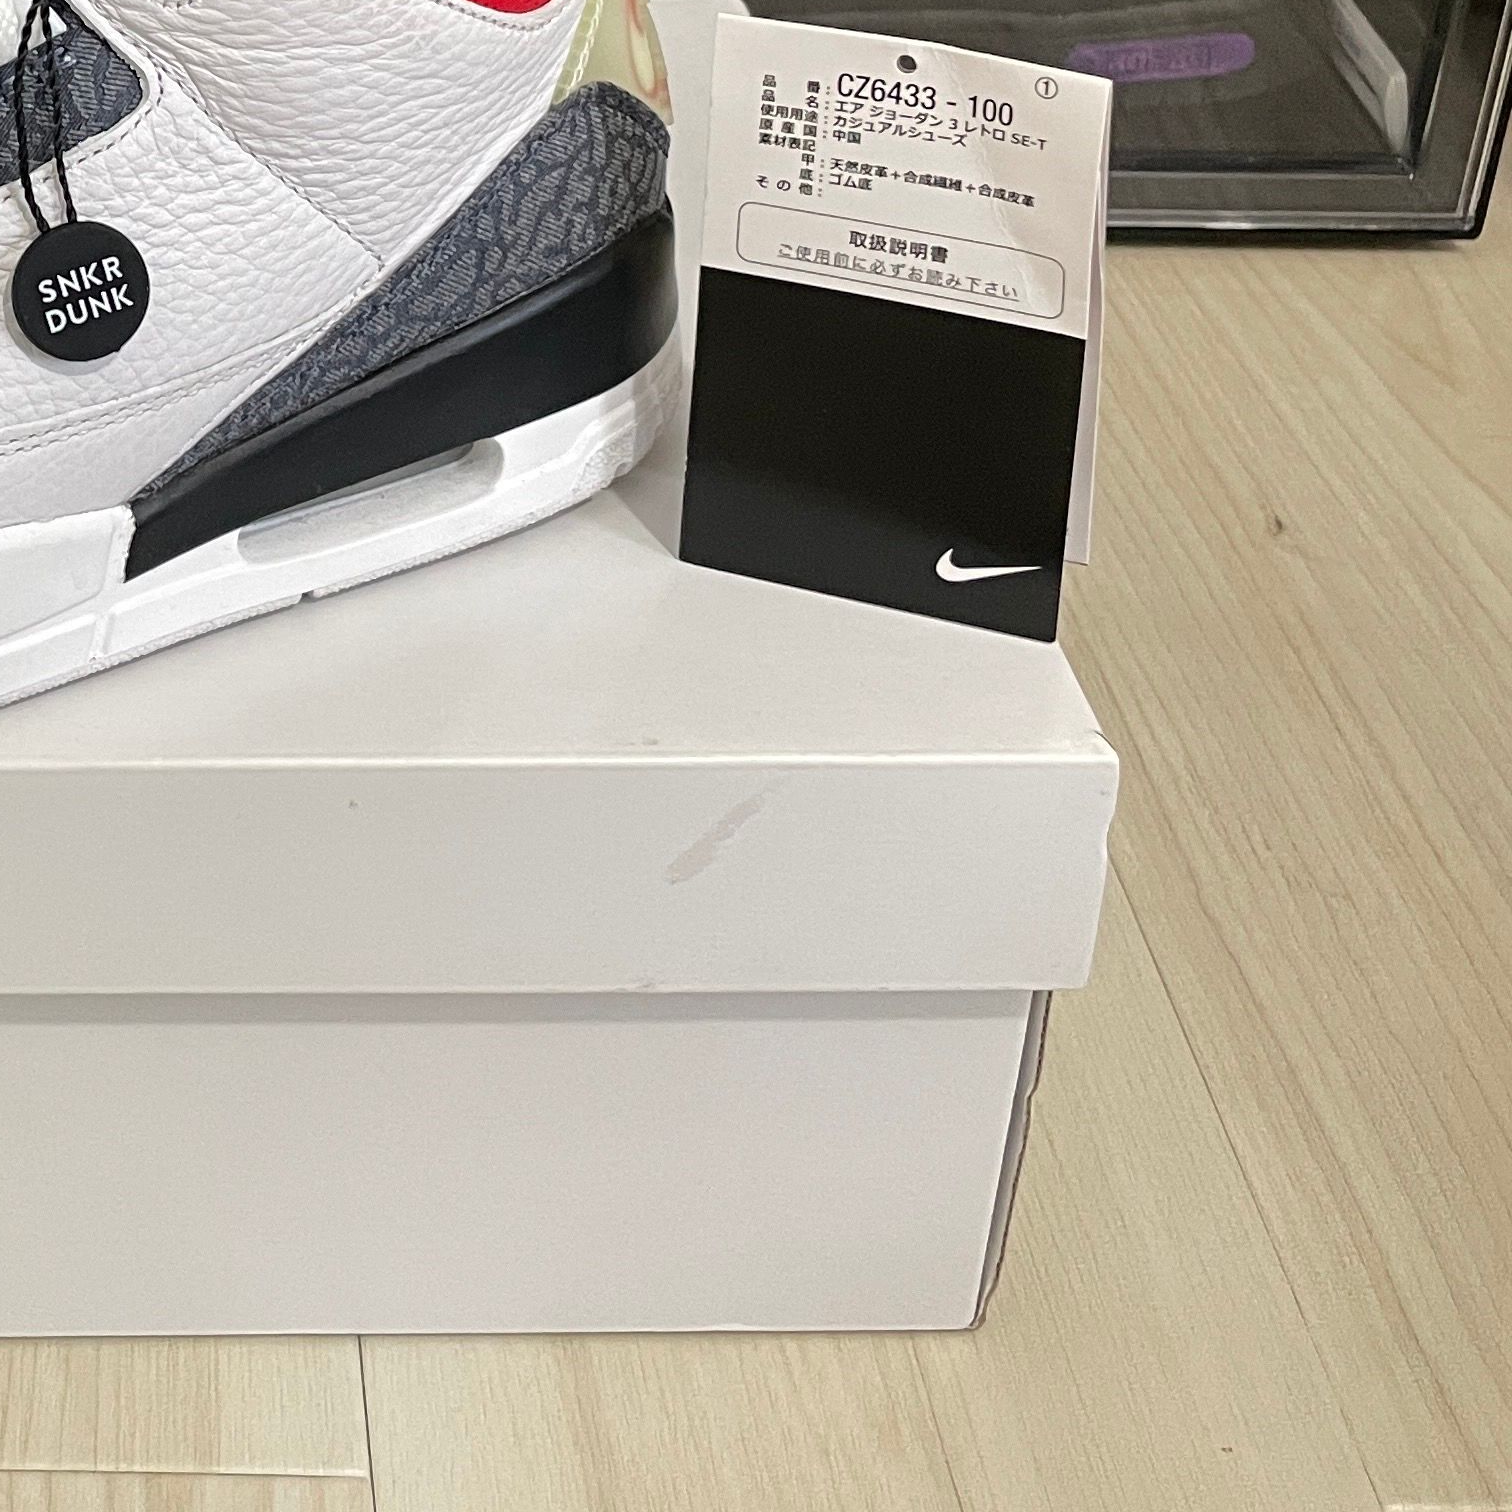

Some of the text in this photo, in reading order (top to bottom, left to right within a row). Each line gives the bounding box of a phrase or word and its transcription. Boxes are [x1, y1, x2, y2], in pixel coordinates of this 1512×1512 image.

[837, 73, 936, 111] CZ6433
[968, 95, 1014, 126] 100
[1010, 133, 1048, 151] SE-T
[848, 230, 949, 264] 取扱説明書
[38, 256, 123, 303] SNKR
[44, 284, 134, 334] DUNK
